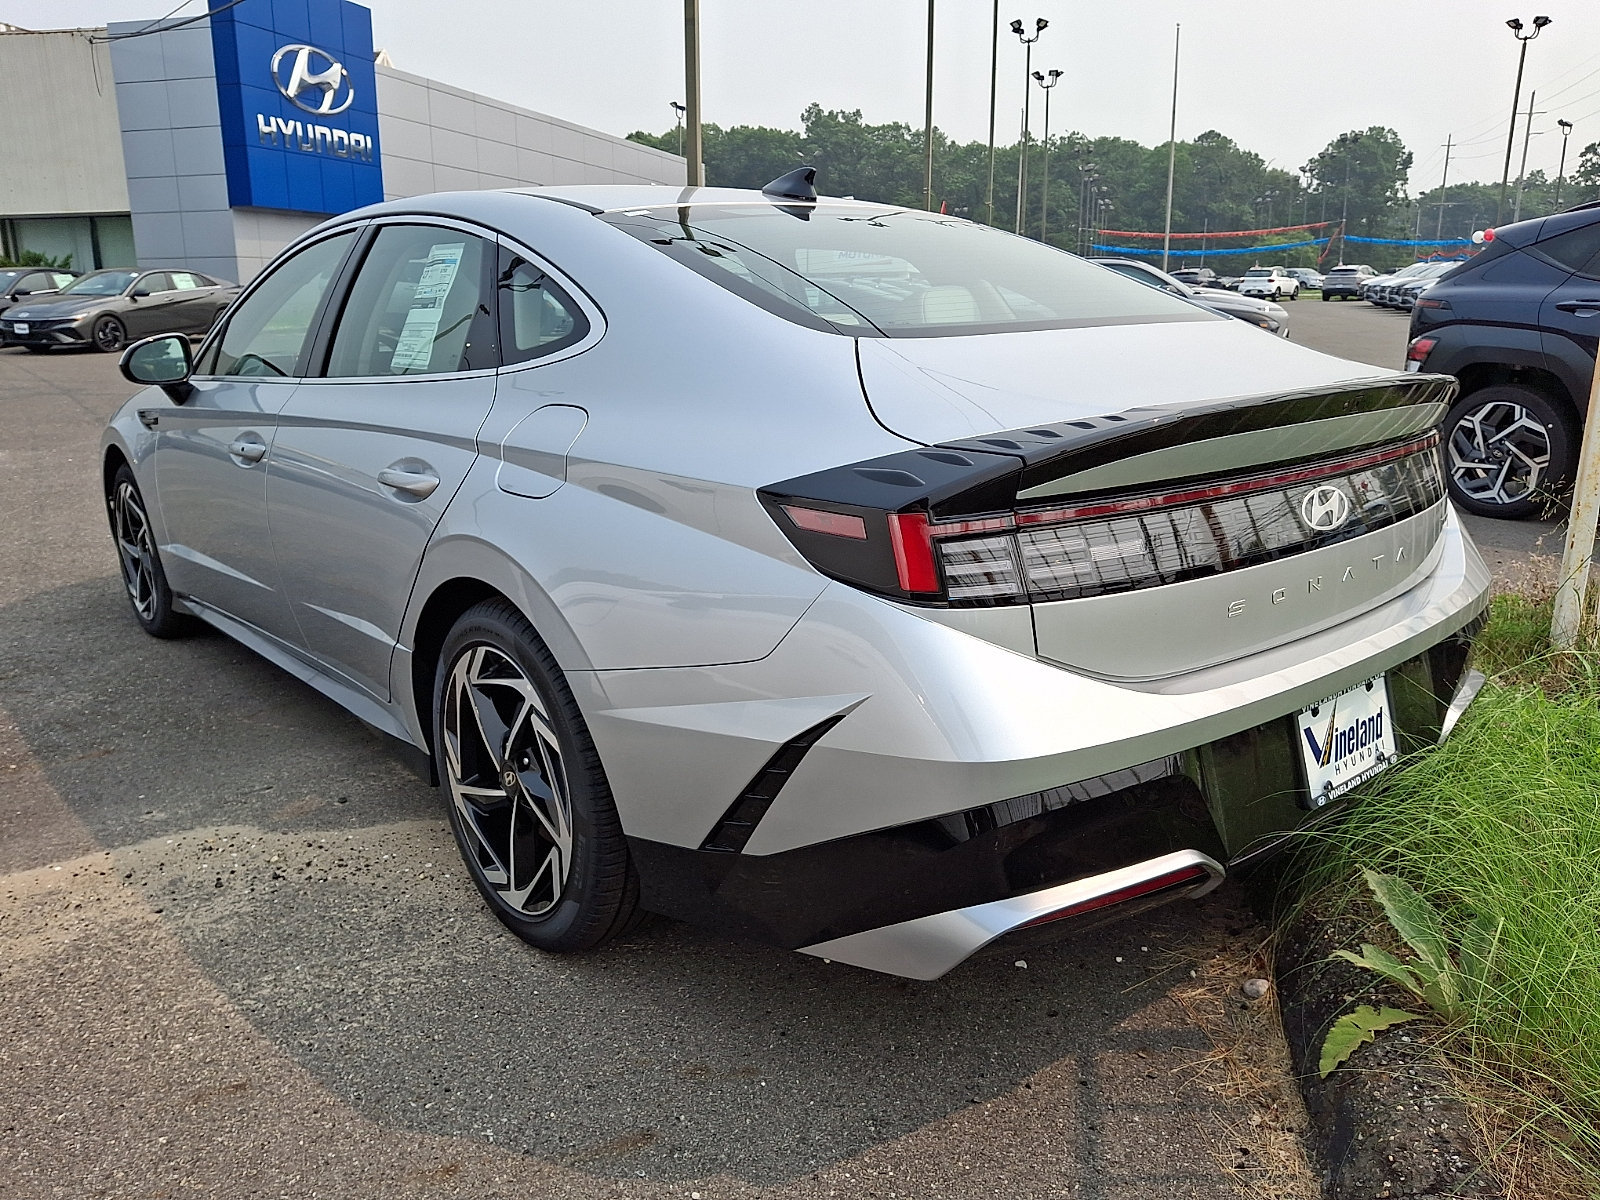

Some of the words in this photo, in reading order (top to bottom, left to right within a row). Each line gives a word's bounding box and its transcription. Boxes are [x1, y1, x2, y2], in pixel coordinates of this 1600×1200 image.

[256, 113, 373, 162] HYUNDAI
[1227, 547, 1406, 618] SONATA
[1303, 699, 1384, 769] Vineland
[1334, 739, 1386, 776] HYUNDAI
[1327, 776, 1361, 800] VINELAND
[1360, 761, 1389, 783] HYUNDAI
